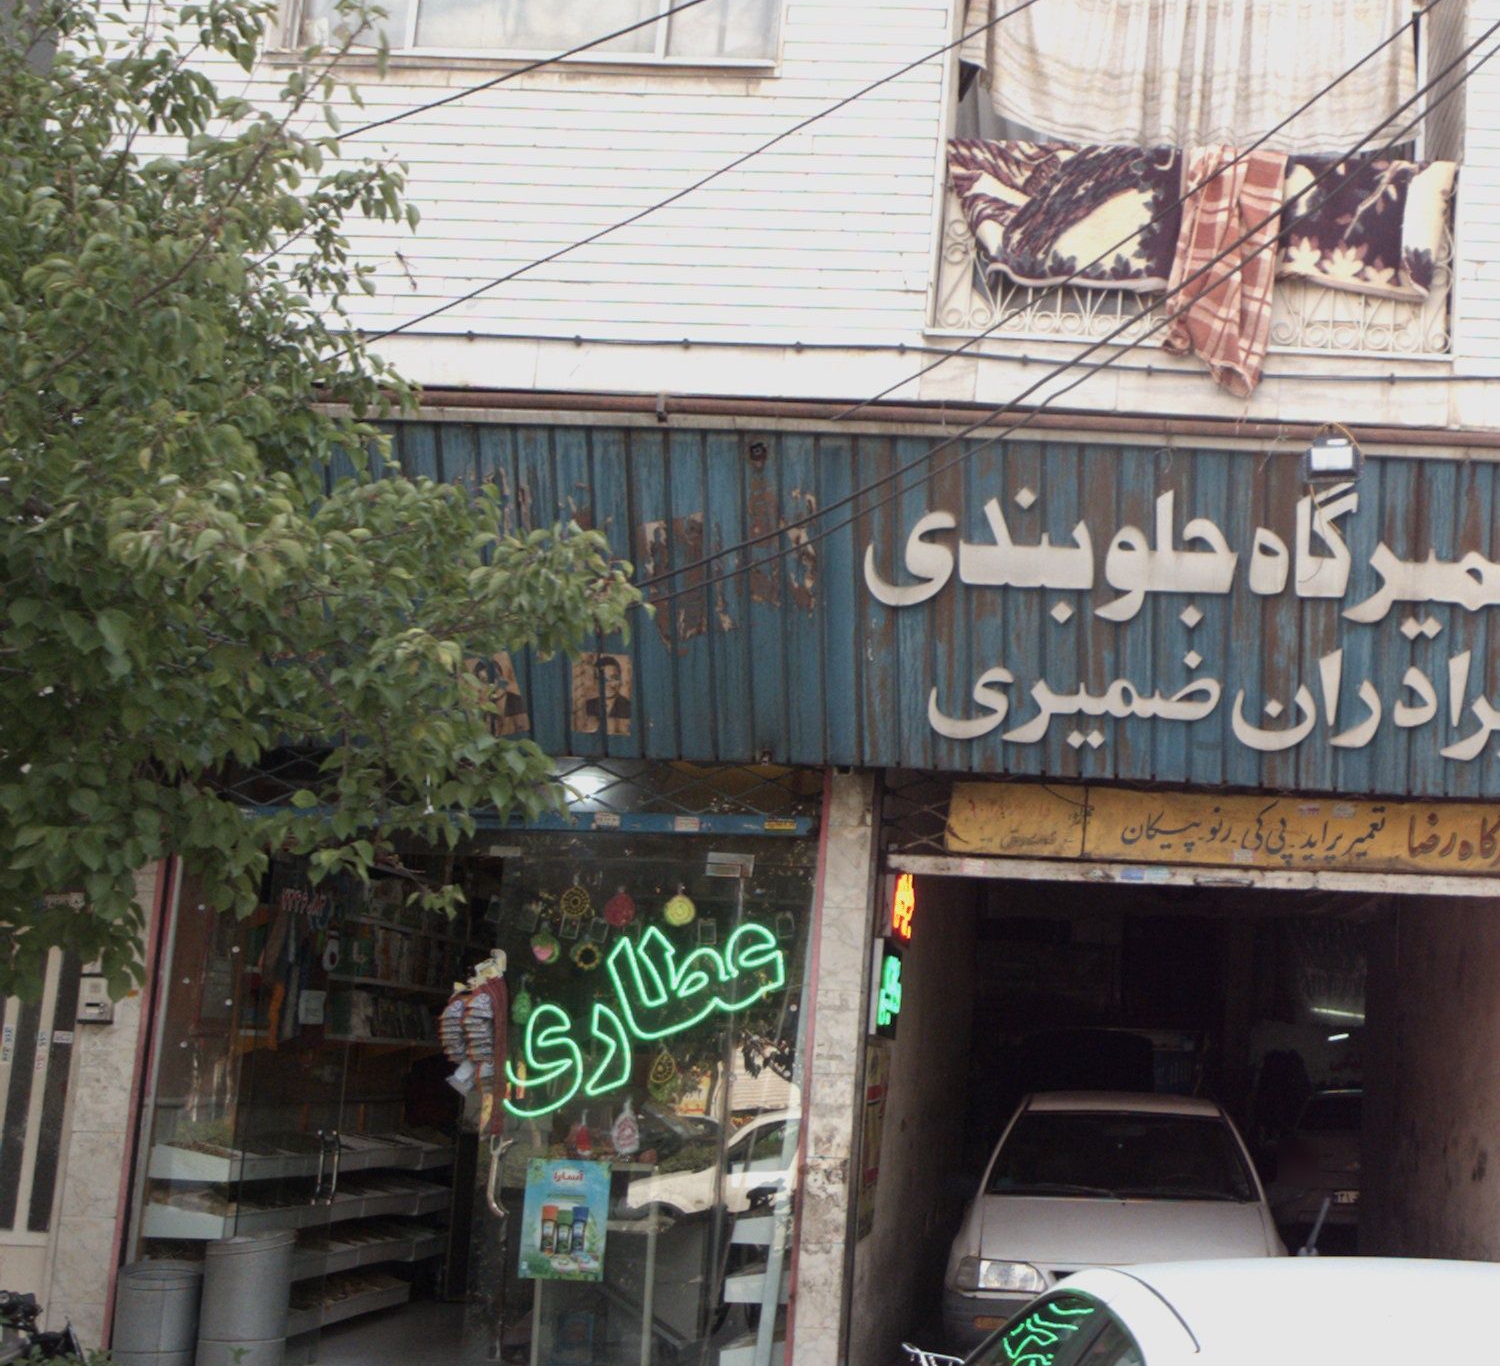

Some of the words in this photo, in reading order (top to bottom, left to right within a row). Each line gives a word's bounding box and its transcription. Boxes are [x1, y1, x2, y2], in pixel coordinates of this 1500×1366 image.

[863, 485, 1238, 628] جلوبندی
[928, 650, 1222, 750] ضمیری
[1343, 806, 1387, 858] تعمیر
[1408, 812, 1456, 858] رضا
[503, 922, 787, 1119] عطاری
